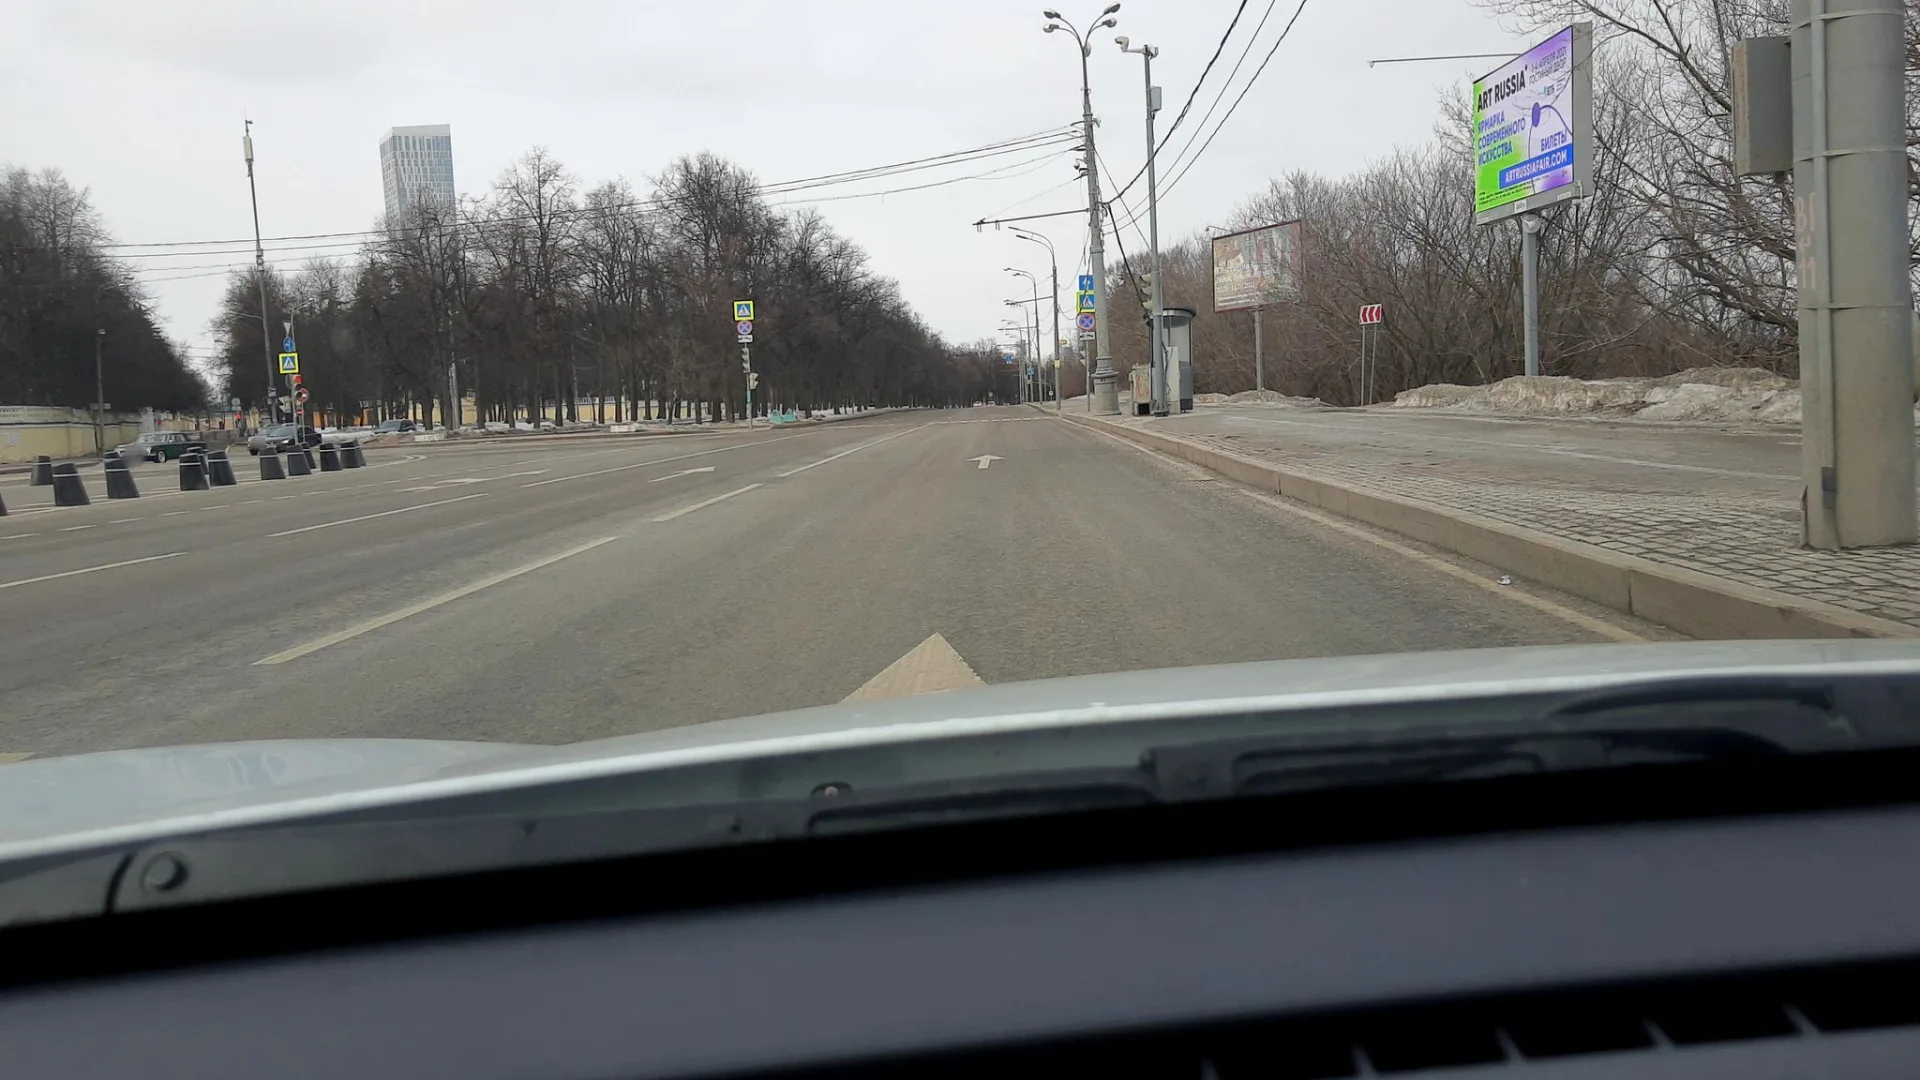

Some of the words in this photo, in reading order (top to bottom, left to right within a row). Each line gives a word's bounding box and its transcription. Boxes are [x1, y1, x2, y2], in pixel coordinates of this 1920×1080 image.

[1477, 87, 1493, 113] ART
[1495, 70, 1526, 104] RUSSIA
[1477, 110, 1505, 135] ЯРМАРКА
[1477, 117, 1526, 150] СОВРЕМЕННОГО
[1478, 139, 1513, 166] ИСКУССТВА
[1540, 129, 1568, 152] БИЛЕТЫ
[1505, 149, 1567, 183] ARTRUSSIAFAIR.COM
